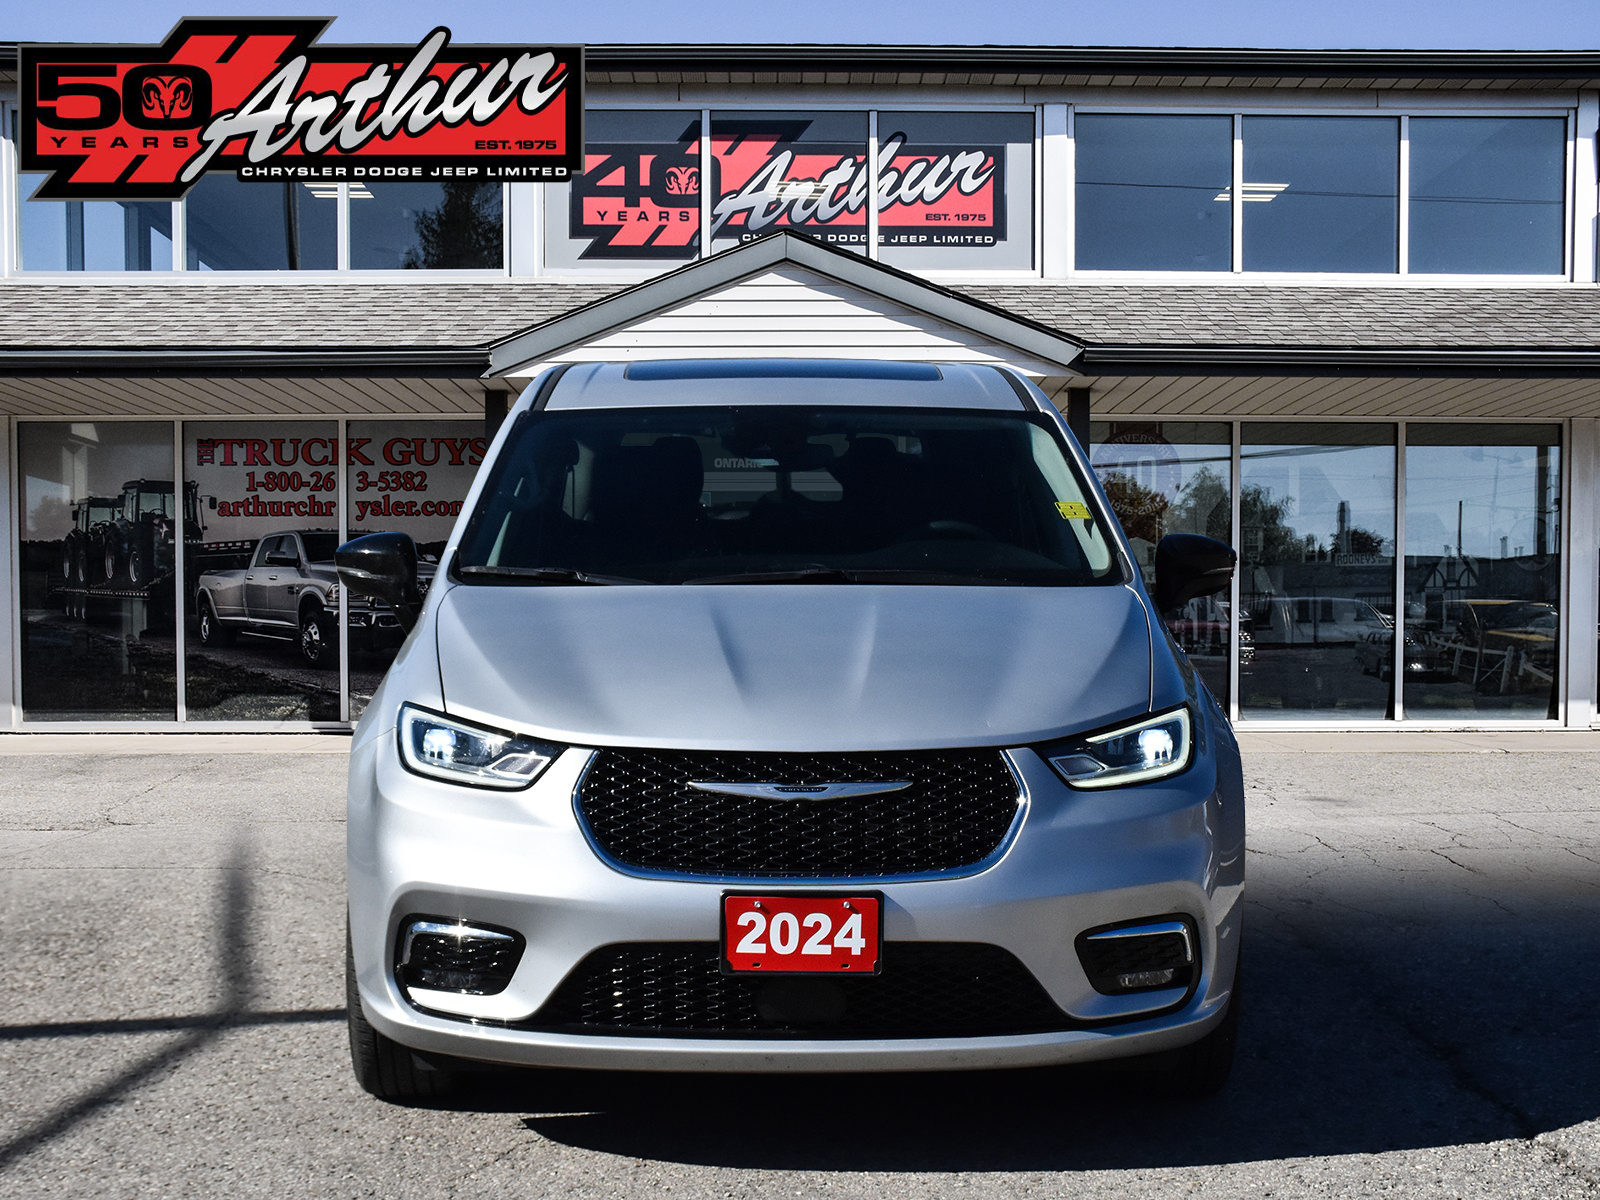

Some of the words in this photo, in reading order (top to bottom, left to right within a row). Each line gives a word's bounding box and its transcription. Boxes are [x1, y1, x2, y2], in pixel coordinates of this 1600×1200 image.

[583, 153, 722, 208] 40
[694, 137, 996, 246] Arthur
[597, 211, 690, 222] YEARS
[925, 213, 952, 221] EST.
[955, 213, 986, 221] 1975
[891, 235, 928, 243] JEEP
[933, 235, 994, 243] LIMITED
[197, 438, 214, 466] THE
[214, 438, 374, 467] TRUCK
[382, 438, 485, 467] GUYS
[735, 911, 866, 956] 2024
